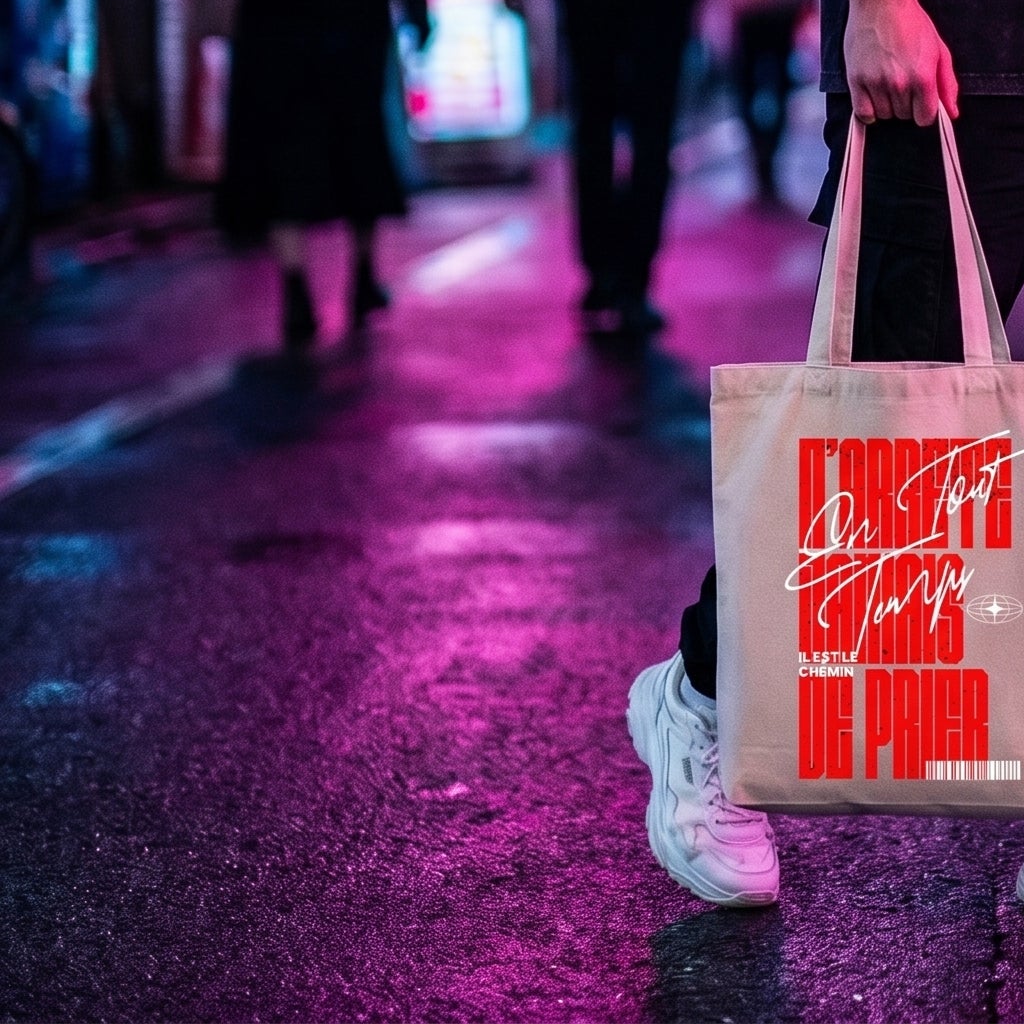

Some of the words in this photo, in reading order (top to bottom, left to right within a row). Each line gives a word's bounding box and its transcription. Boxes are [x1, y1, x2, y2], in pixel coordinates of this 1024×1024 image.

[798, 651, 811, 663] IL
[813, 651, 839, 664] EST
[841, 651, 858, 663] LE
[798, 666, 854, 678] CHEMIN
[798, 671, 853, 780] DE
[865, 668, 989, 780] PRIER
